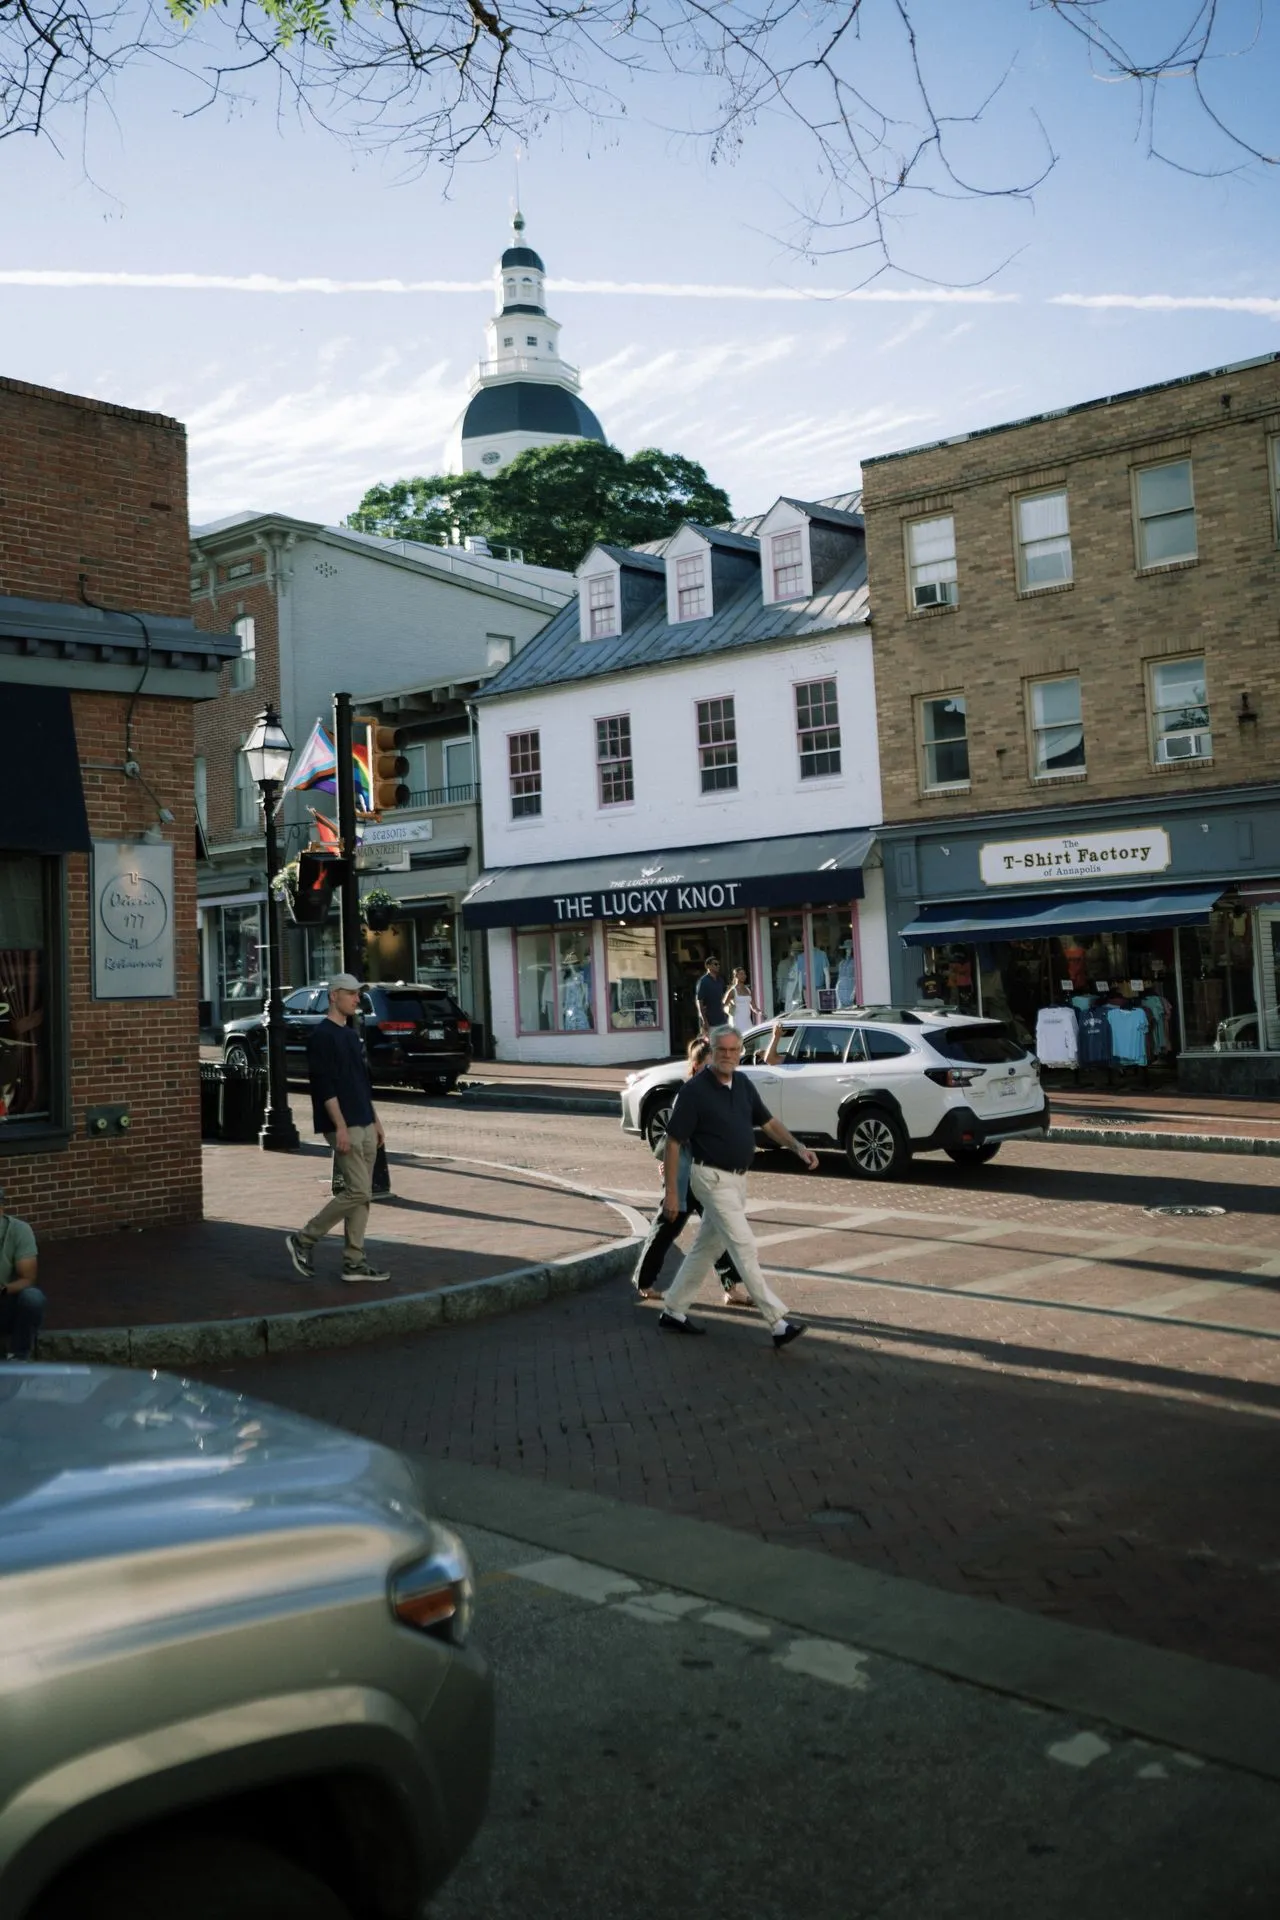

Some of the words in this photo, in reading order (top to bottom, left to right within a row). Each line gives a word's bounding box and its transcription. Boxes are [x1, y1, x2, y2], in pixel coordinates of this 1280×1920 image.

[357, 846, 375, 857] MAIN
[376, 843, 400, 855] STREET
[1062, 840, 1079, 849] The
[1003, 852, 1071, 870] T-Shirt
[1077, 847, 1151, 862] Factory
[1043, 868, 1052, 877] of
[1056, 865, 1101, 877] Annapolis
[609, 879, 626, 888] THE
[627, 876, 655, 887] LUCKY
[656, 874, 683, 884] KNOT
[553, 896, 594, 919] THE
[601, 889, 669, 916] LUCKY
[677, 883, 739, 910] KNOT
